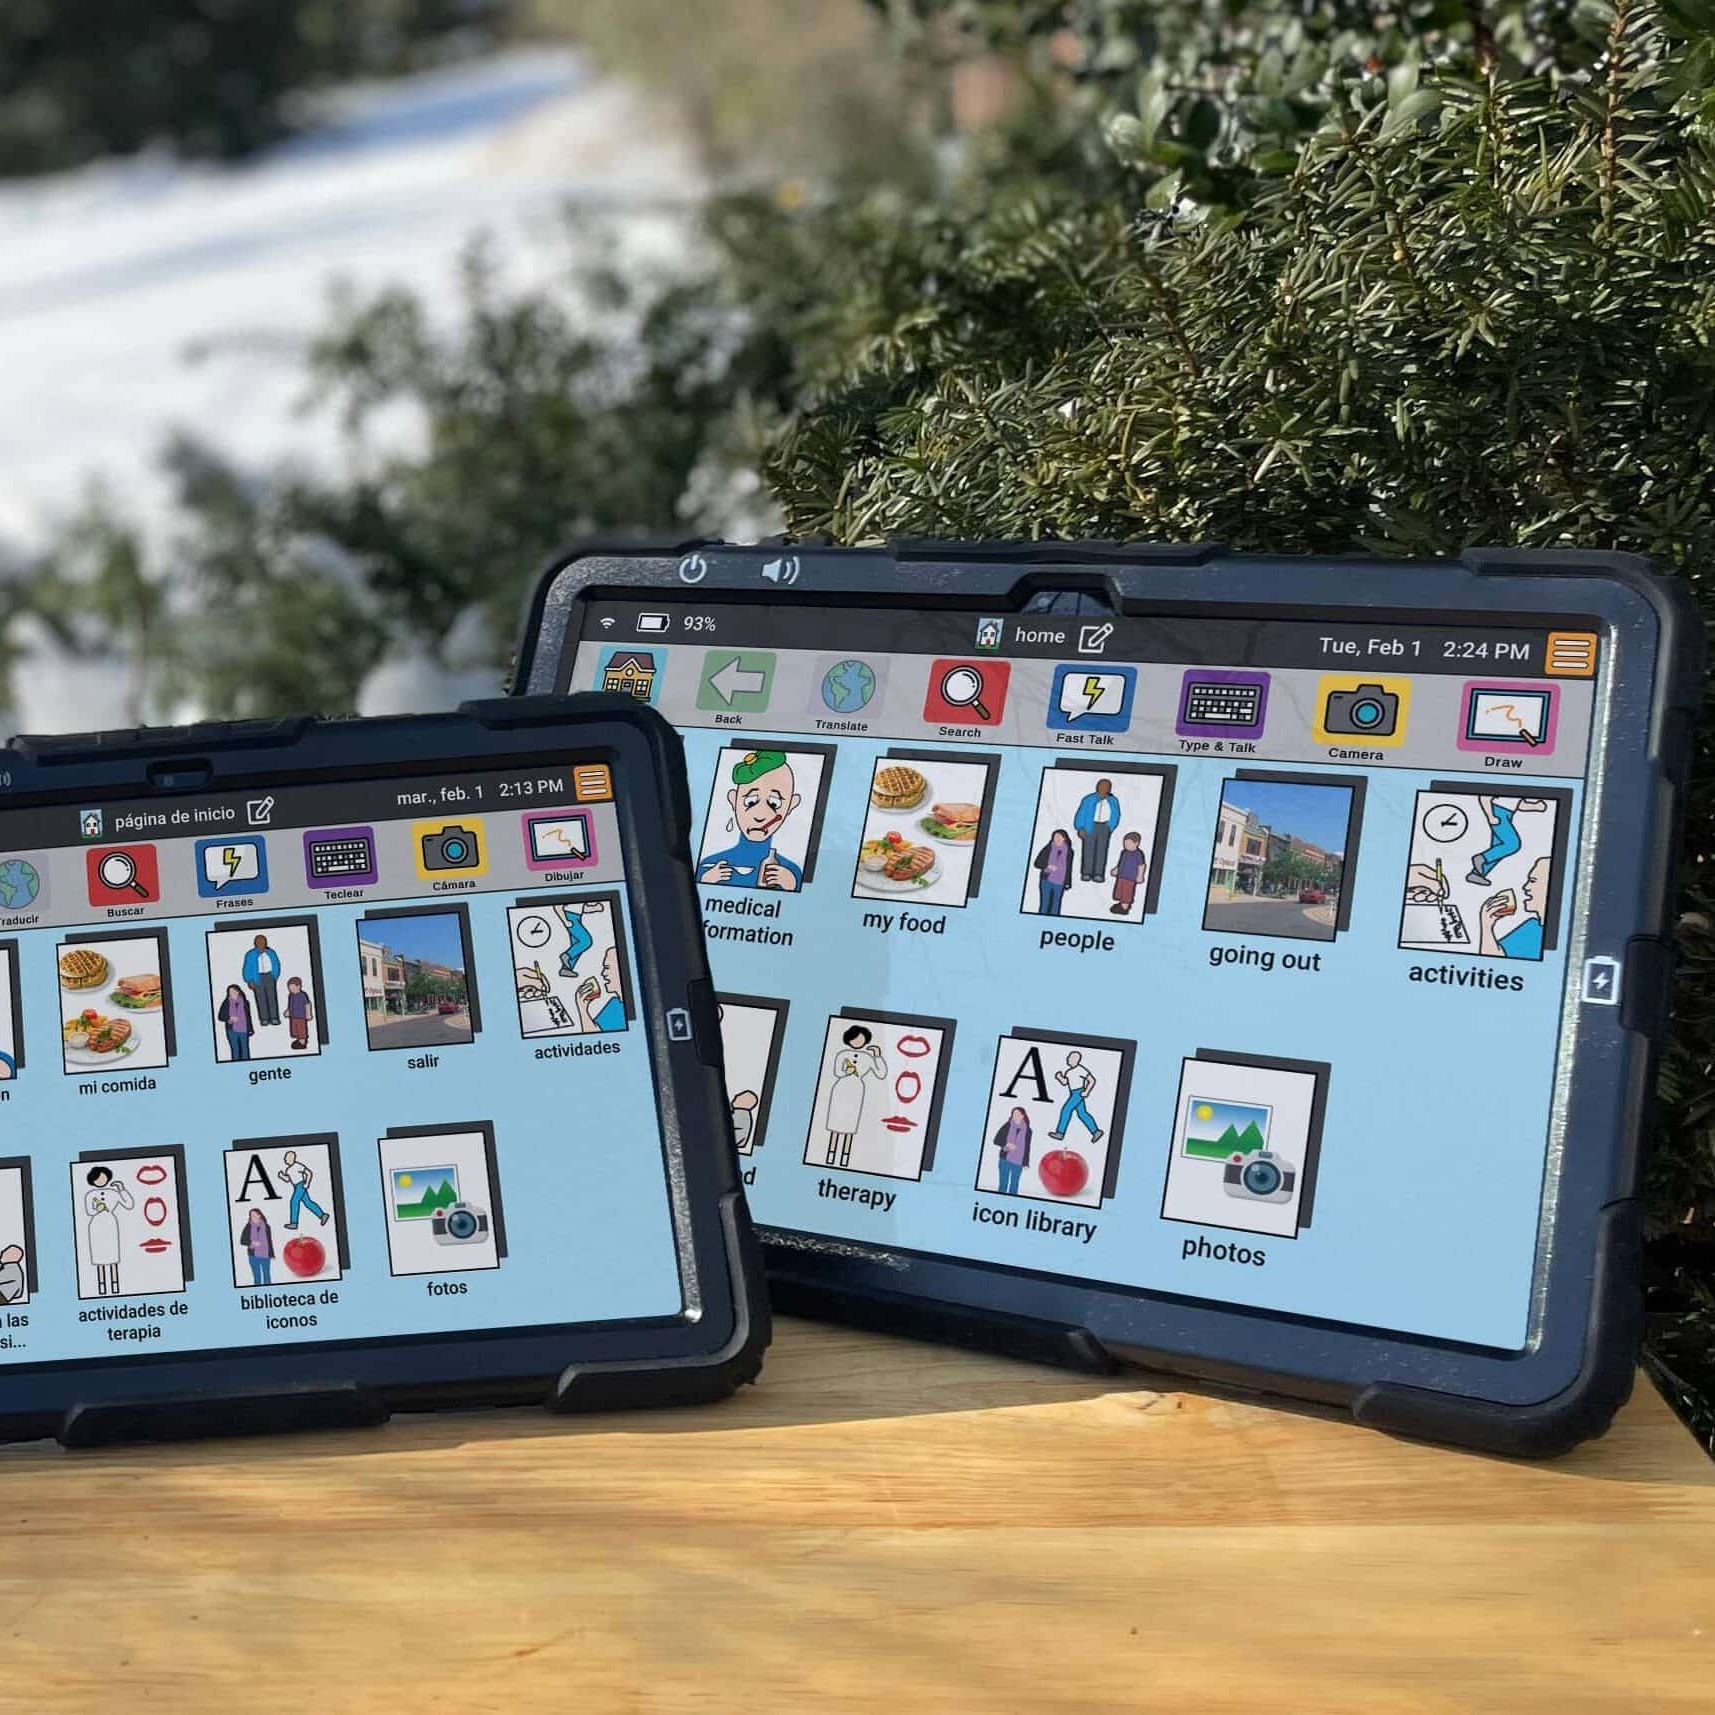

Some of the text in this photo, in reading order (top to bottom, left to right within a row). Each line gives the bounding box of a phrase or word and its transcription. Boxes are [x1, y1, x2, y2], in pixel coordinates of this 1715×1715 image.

[683, 615, 716, 632] 93%
[1015, 626, 1066, 644] home
[1319, 637, 1421, 657] Tue, Feb 1
[1443, 641, 1530, 660] 2:24 PM
[714, 714, 743, 725] Back
[815, 719, 869, 732] Translate
[938, 726, 982, 738] Search
[1056, 732, 1114, 745] Fast Talk
[1178, 739, 1256, 753] Type & Talk
[1328, 747, 1384, 761] Camera
[1484, 756, 1523, 769] Draw
[396, 785, 483, 806] mar., feb. 1
[498, 778, 564, 797] 2:13 PM
[115, 806, 235, 832] página de inicio
[432, 880, 477, 891] Cámara
[544, 871, 584, 882] Dibujar
[216, 898, 254, 909] Frases
[324, 888, 364, 900] Teclear
[106, 907, 144, 918] Buscar
[705, 896, 782, 919] medical
[862, 911, 947, 935] my food
[703, 919, 794, 947] formation
[1039, 930, 1115, 954] people
[1209, 944, 1322, 972] going out
[1408, 964, 1524, 992] activities
[534, 1040, 621, 1060] actividades
[407, 1053, 440, 1070] salir
[248, 1067, 292, 1086] gente
[998, 1046, 1055, 1104] A
[78, 1075, 157, 1095] mi comida
[234, 1153, 283, 1203] A
[817, 1177, 897, 1213] therapy
[972, 1201, 1098, 1245] icon library
[1181, 1235, 1266, 1267] photos
[426, 1281, 468, 1297] fotos
[240, 1289, 339, 1311] biblioteca de
[6, 1312, 29, 1328] las
[78, 1300, 189, 1323] actividades de
[265, 1314, 318, 1330] iconos
[107, 1323, 161, 1343] terapia
